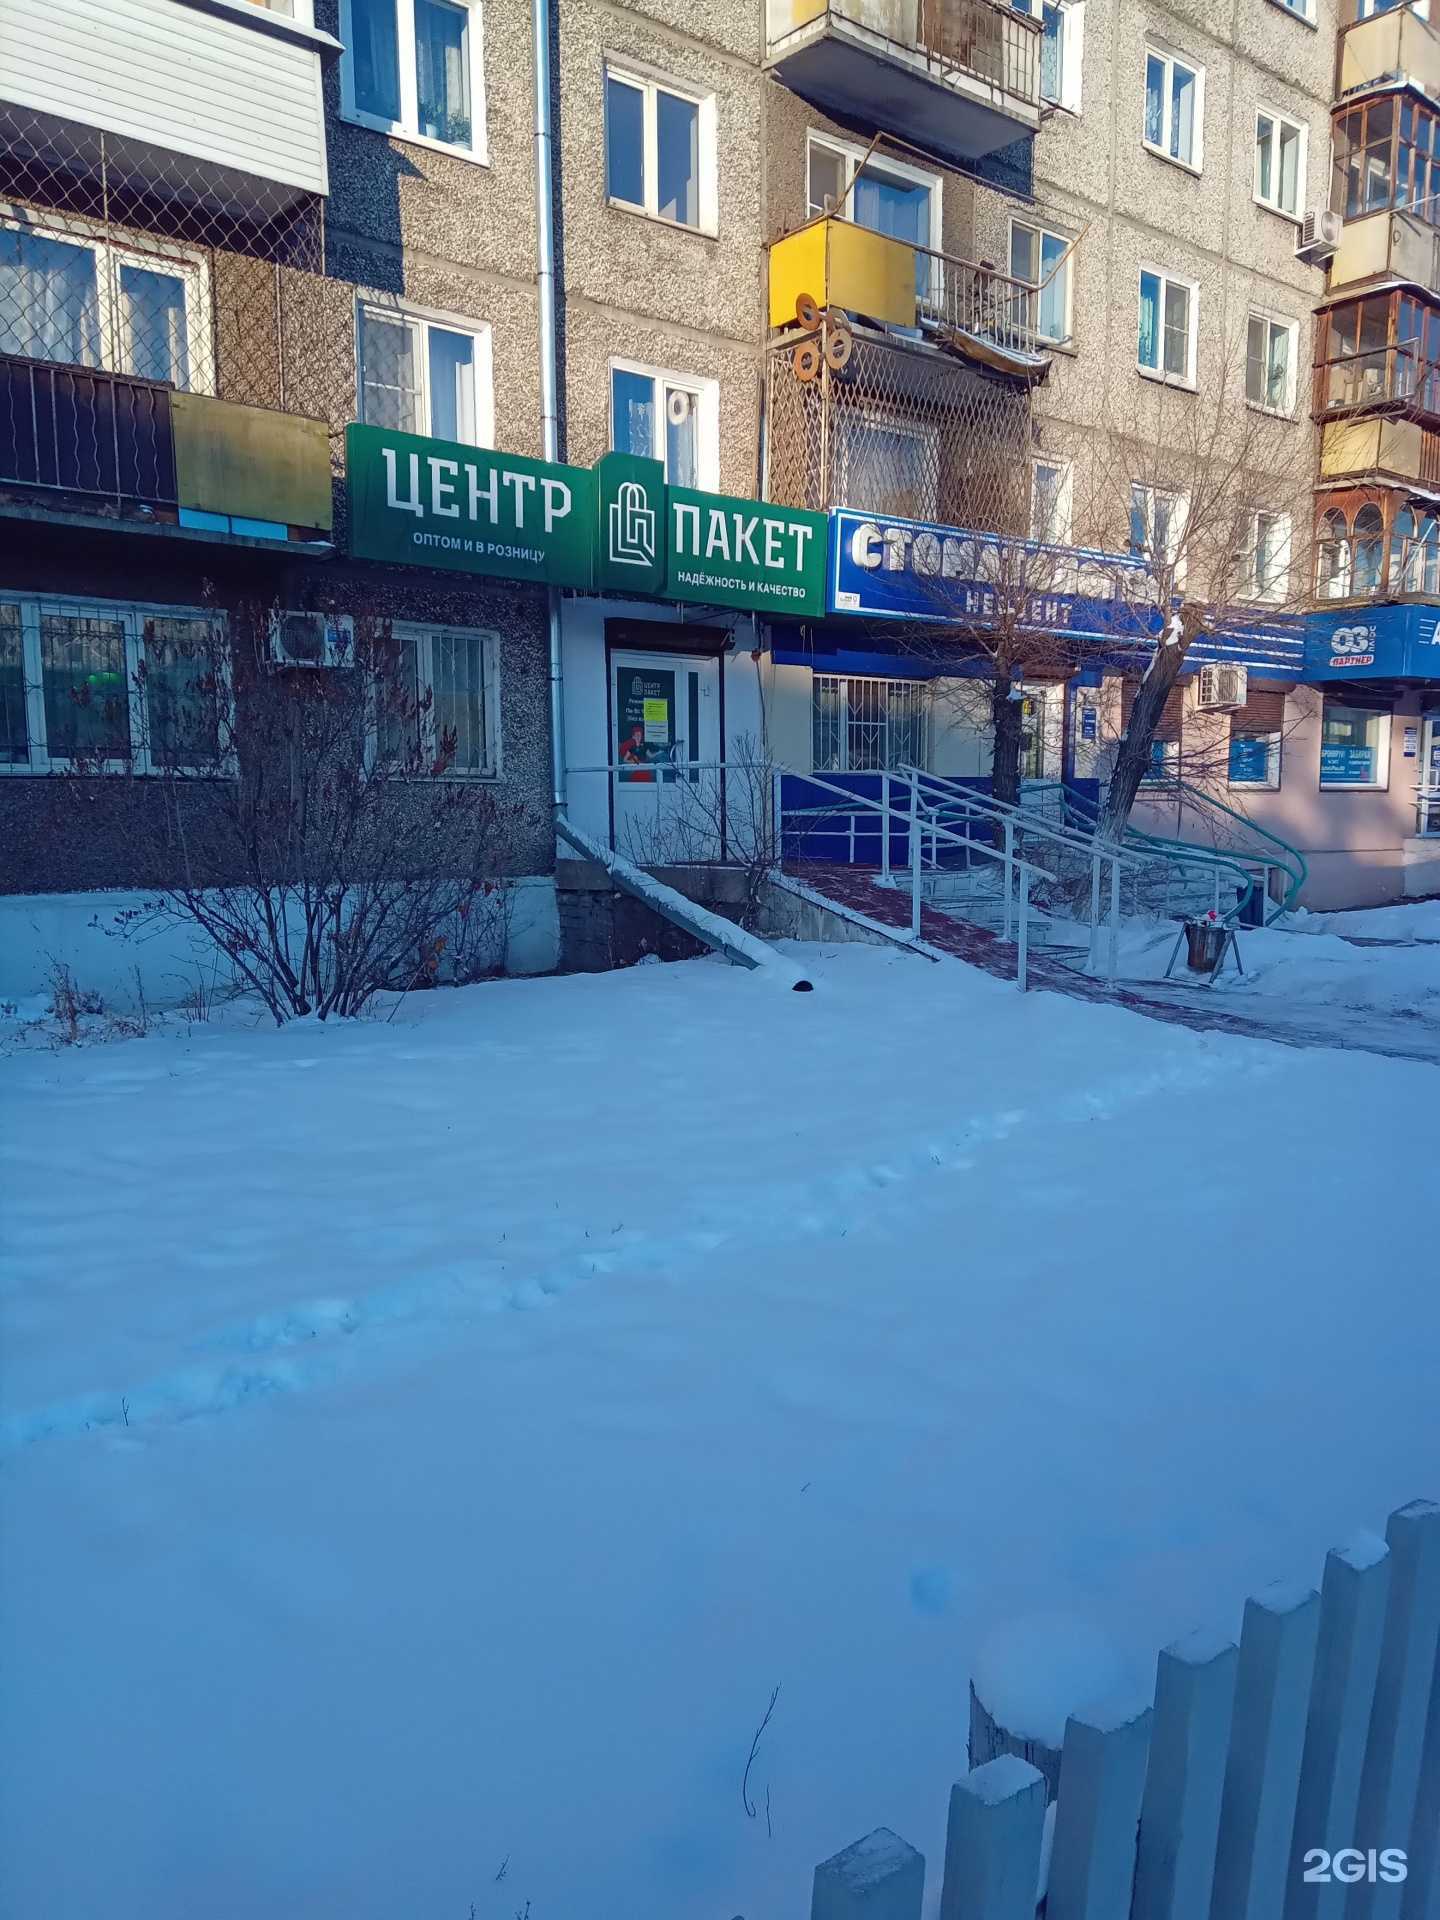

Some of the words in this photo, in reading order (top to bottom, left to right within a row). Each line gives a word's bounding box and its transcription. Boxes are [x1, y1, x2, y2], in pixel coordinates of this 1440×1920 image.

[382, 447, 572, 533] ЦЕНТР
[412, 531, 462, 553] ОПТОМ
[463, 539, 474, 553] И
[475, 541, 485, 555] В
[486, 542, 545, 563] РОЗНИЦУ
[673, 502, 813, 571] ПАКЕТ
[677, 569, 747, 592] НАДЁЖНОСТЬ
[748, 581, 756, 593] И
[757, 581, 806, 599] КАЧЕСТВО
[966, 590, 1073, 625] НЕЕНТ
